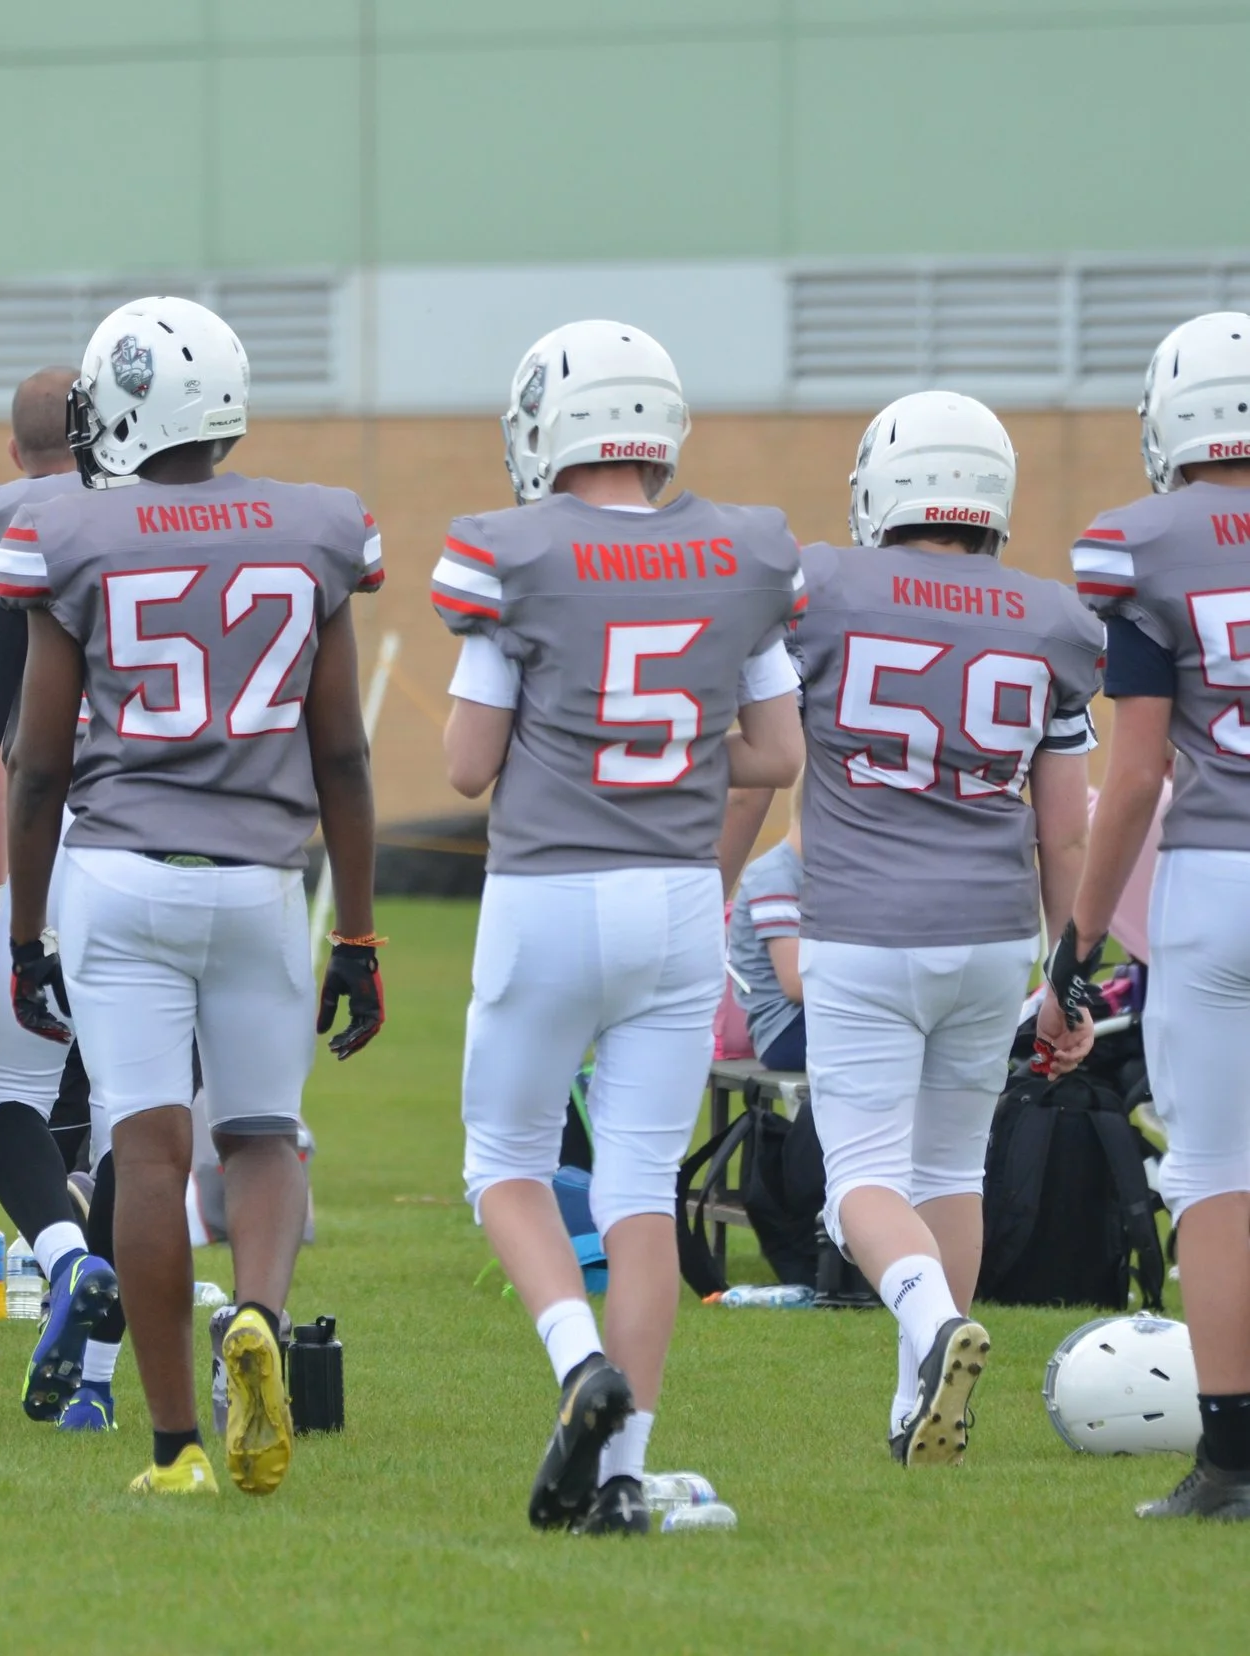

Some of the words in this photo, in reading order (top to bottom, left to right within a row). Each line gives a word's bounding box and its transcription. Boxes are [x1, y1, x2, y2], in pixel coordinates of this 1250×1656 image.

[600, 442, 667, 460] Riddell
[136, 502, 273, 534] KNIGHTS
[925, 507, 990, 525] Riddell
[572, 537, 738, 581] KNIGHTS
[893, 575, 1026, 621] KNIGHTS
[102, 562, 321, 743] 52
[1185, 587, 1250, 759] 5
[592, 617, 713, 788] 5
[835, 631, 1054, 800] 59
